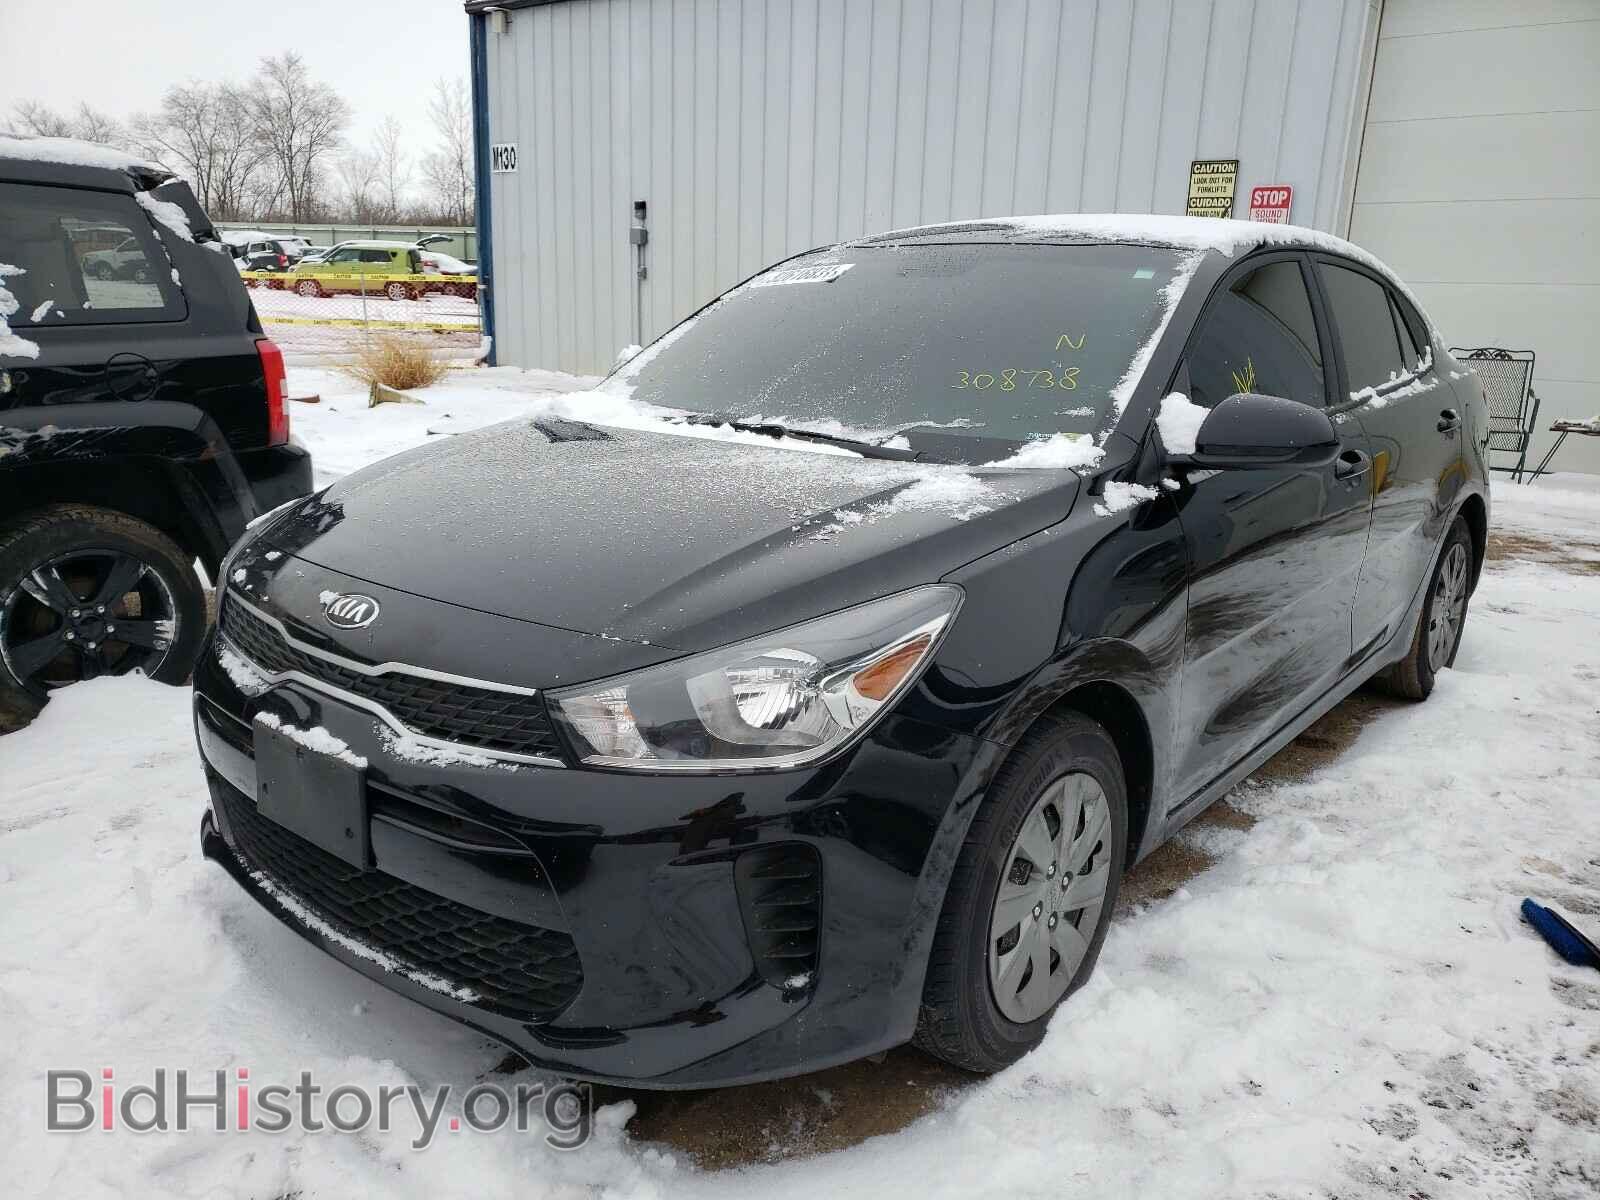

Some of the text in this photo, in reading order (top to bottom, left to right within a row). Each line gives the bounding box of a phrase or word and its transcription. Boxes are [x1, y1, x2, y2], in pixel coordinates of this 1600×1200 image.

[492, 146, 516, 170] M130
[1193, 163, 1235, 174] CAUTION
[1193, 177, 1208, 185] LOOK
[1221, 176, 1233, 184] FOR
[1197, 185, 1227, 193] FORKLIFTS
[1190, 198, 1231, 207] CUIDADO
[1253, 190, 1288, 206] STOP
[1255, 209, 1282, 219] SOUND
[1055, 334, 1086, 351] N
[951, 367, 1080, 391] 308738
[327, 598, 369, 623] KIA
